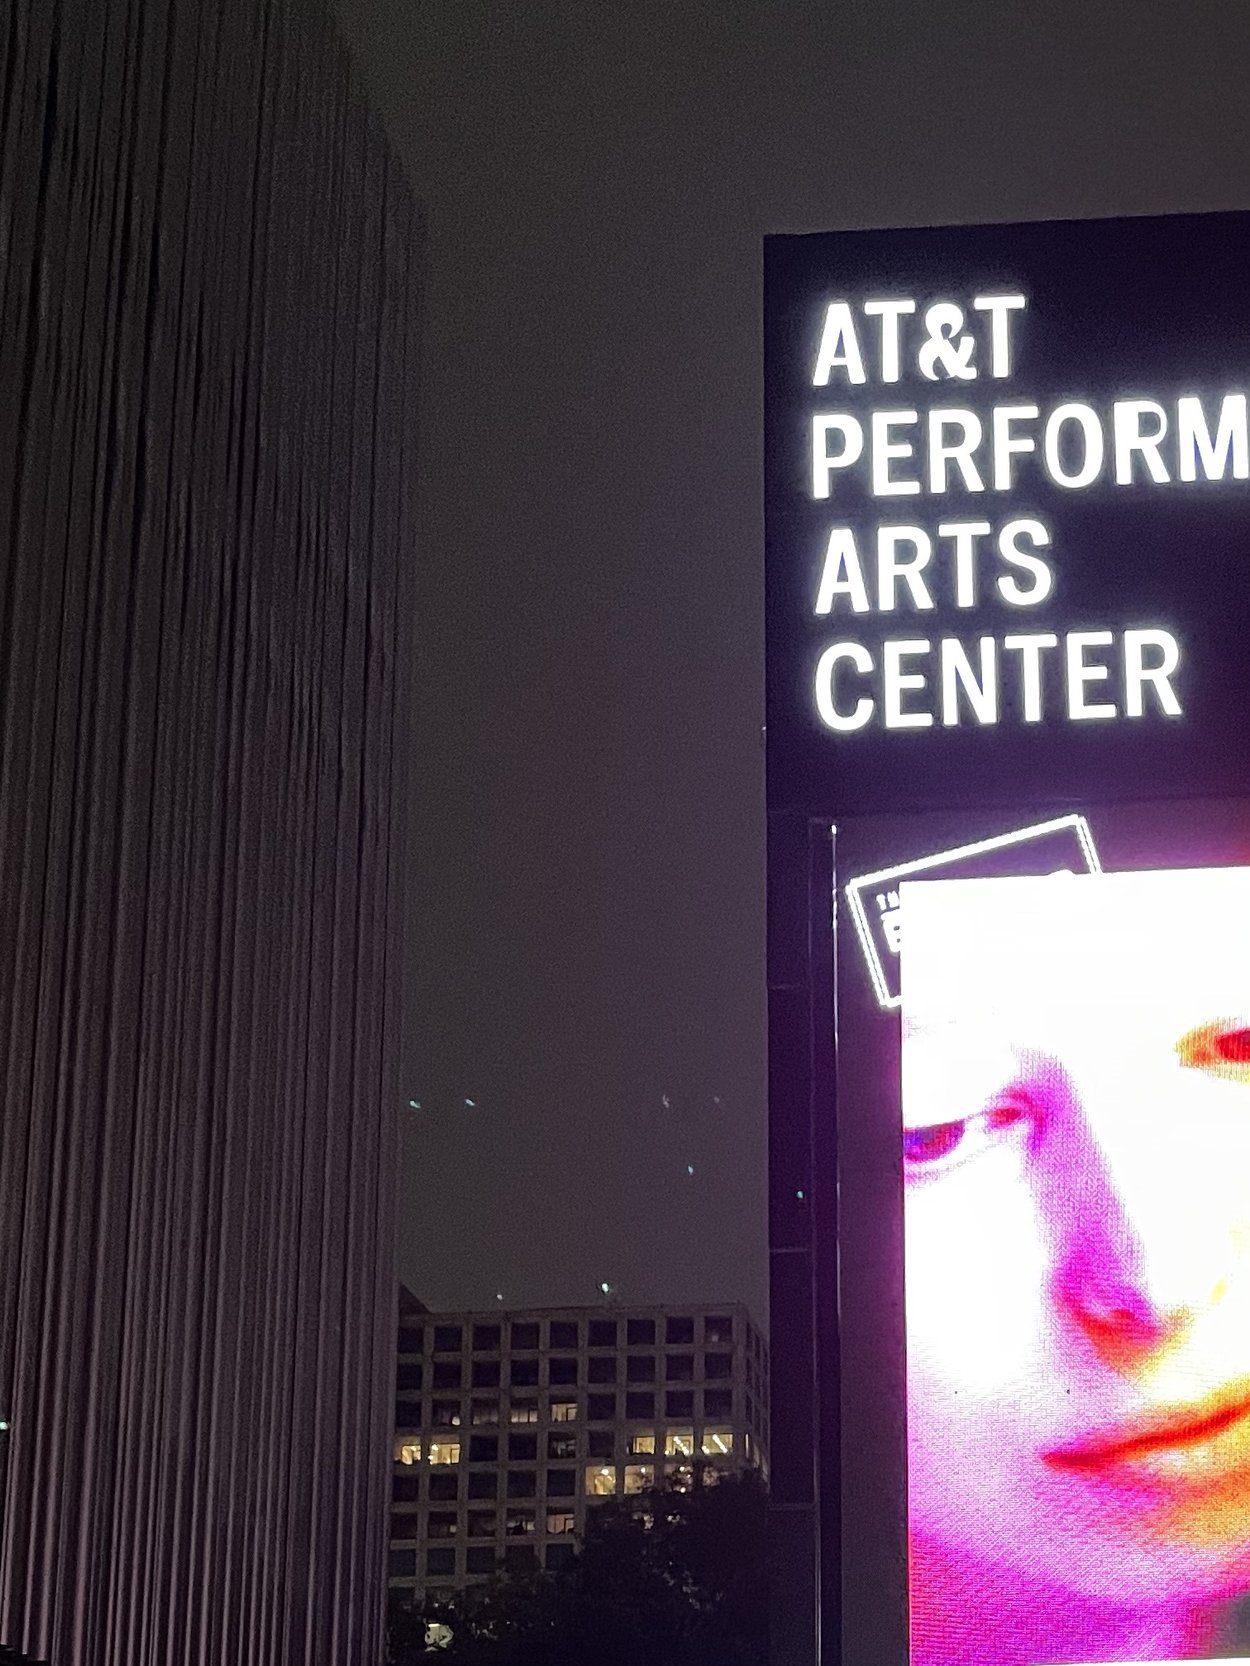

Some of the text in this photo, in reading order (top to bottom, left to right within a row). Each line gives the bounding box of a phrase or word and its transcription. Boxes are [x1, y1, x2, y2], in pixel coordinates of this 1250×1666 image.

[812, 294, 1026, 387] AT&T
[815, 519, 1052, 615] ARTS
[815, 628, 1183, 731] CENTER
